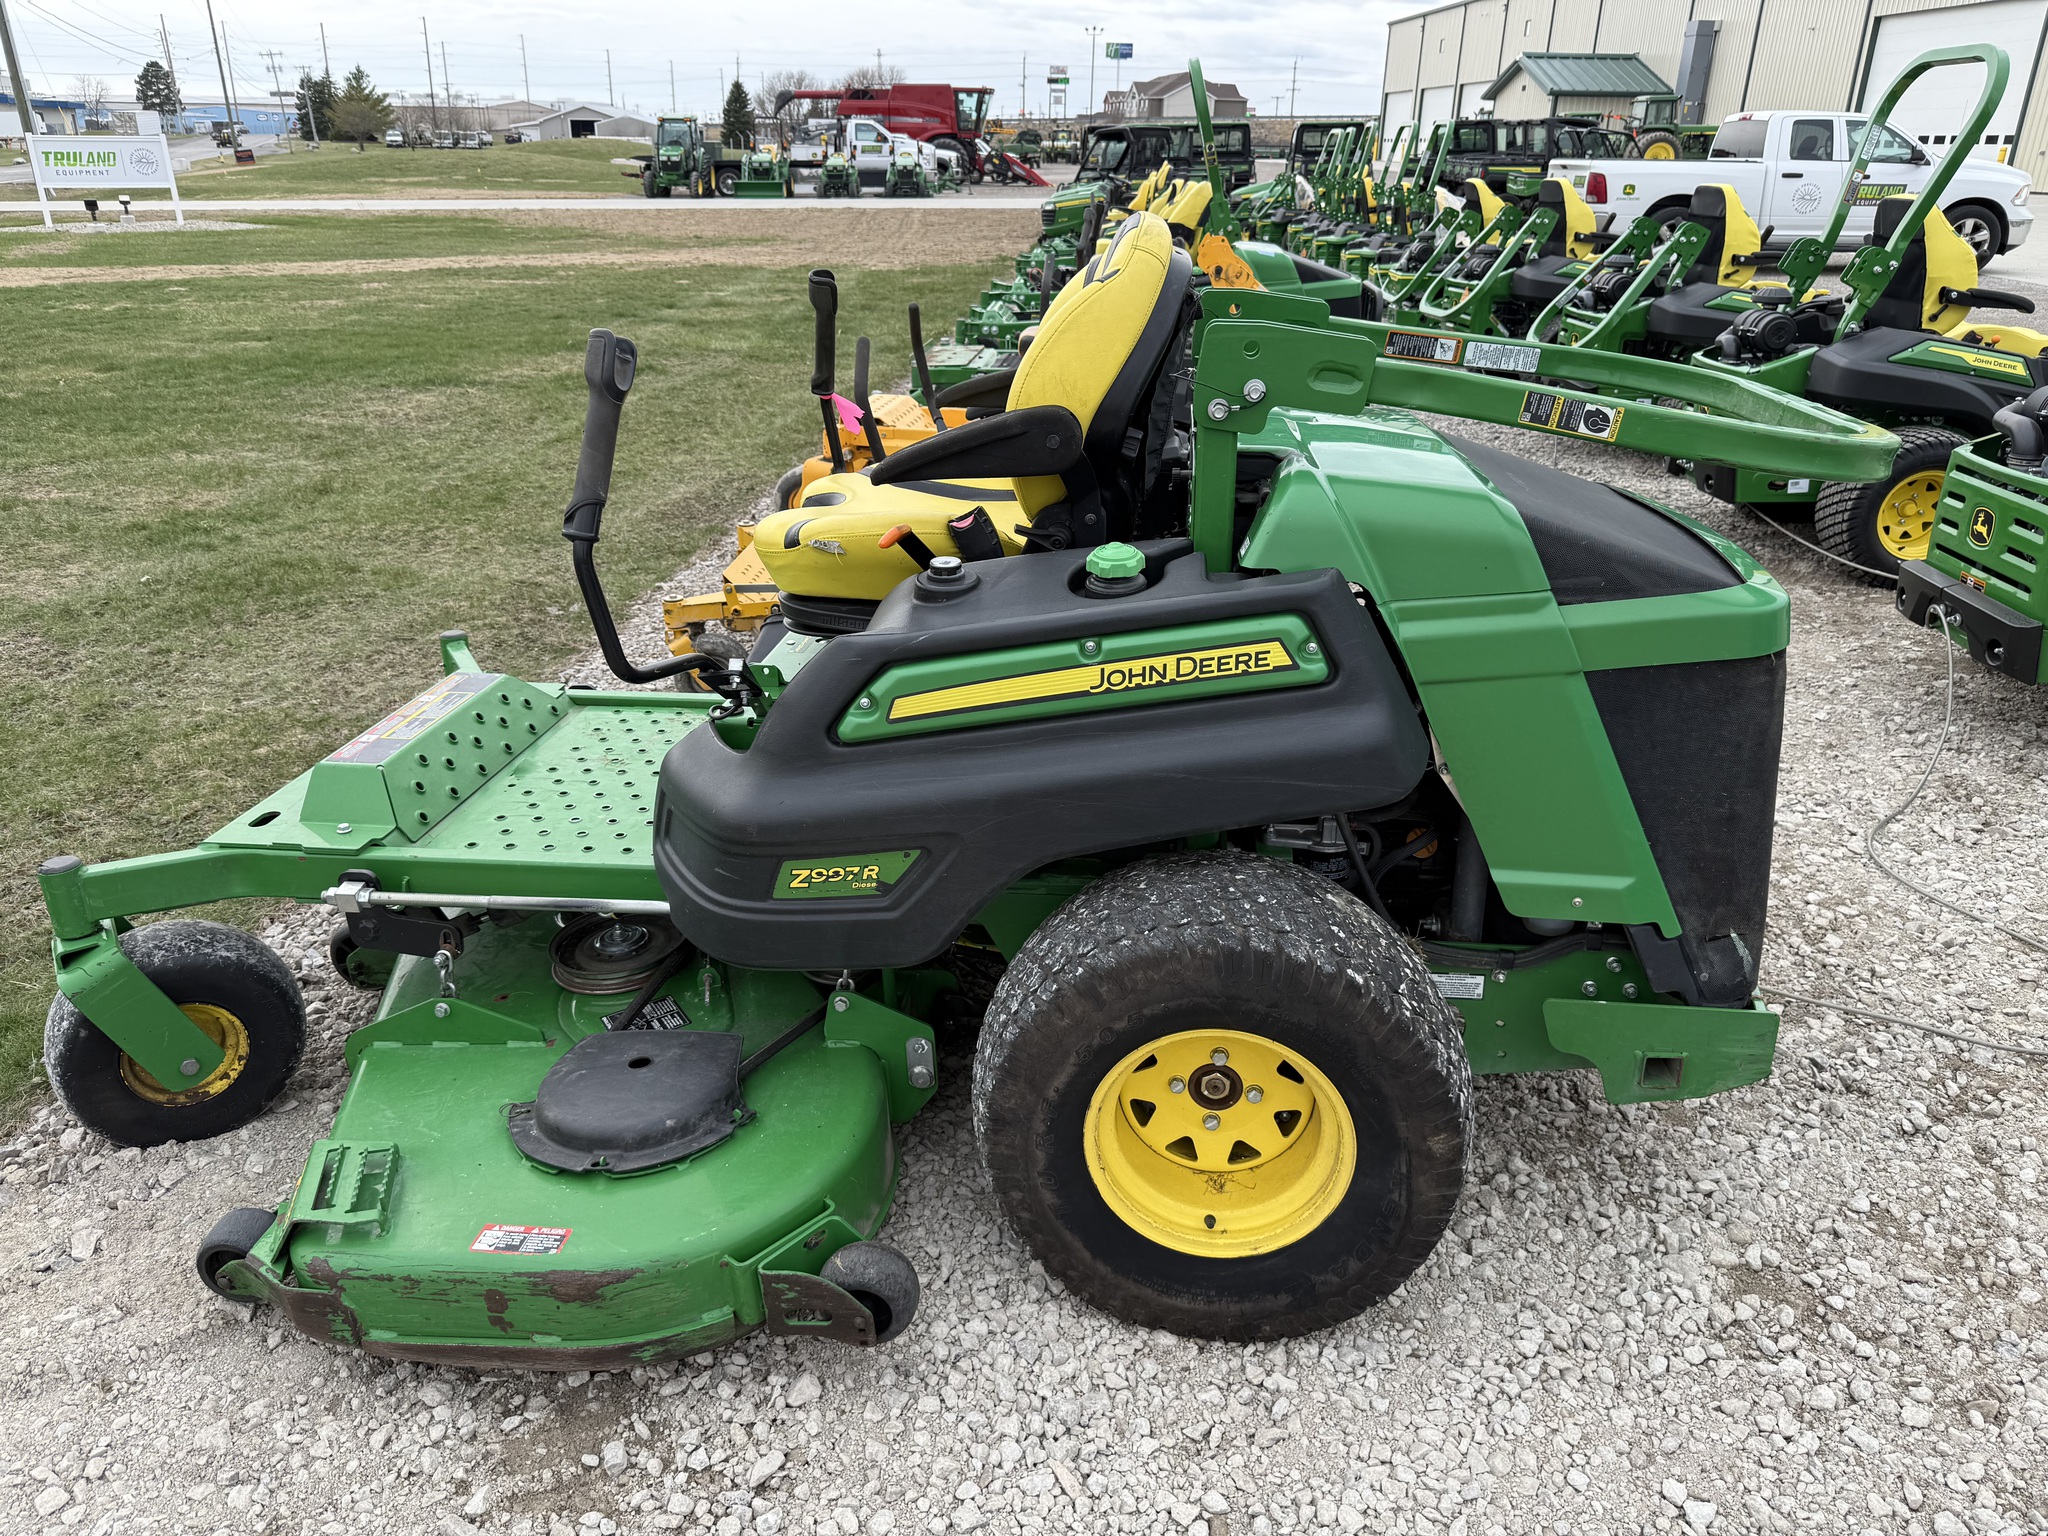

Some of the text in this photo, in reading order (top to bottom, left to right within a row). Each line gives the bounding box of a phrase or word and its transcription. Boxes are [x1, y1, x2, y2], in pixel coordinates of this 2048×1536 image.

[41, 151, 116, 167] TRULAND
[1857, 185, 1904, 199] RULAND
[1972, 356, 2018, 370] JOHN DEERE
[1610, 415, 1621, 439] CAUTION
[1090, 650, 1271, 690] JOHN DEERE
[1074, 1009, 1145, 1065] 505
[1327, 1166, 1411, 1281] KENDA
